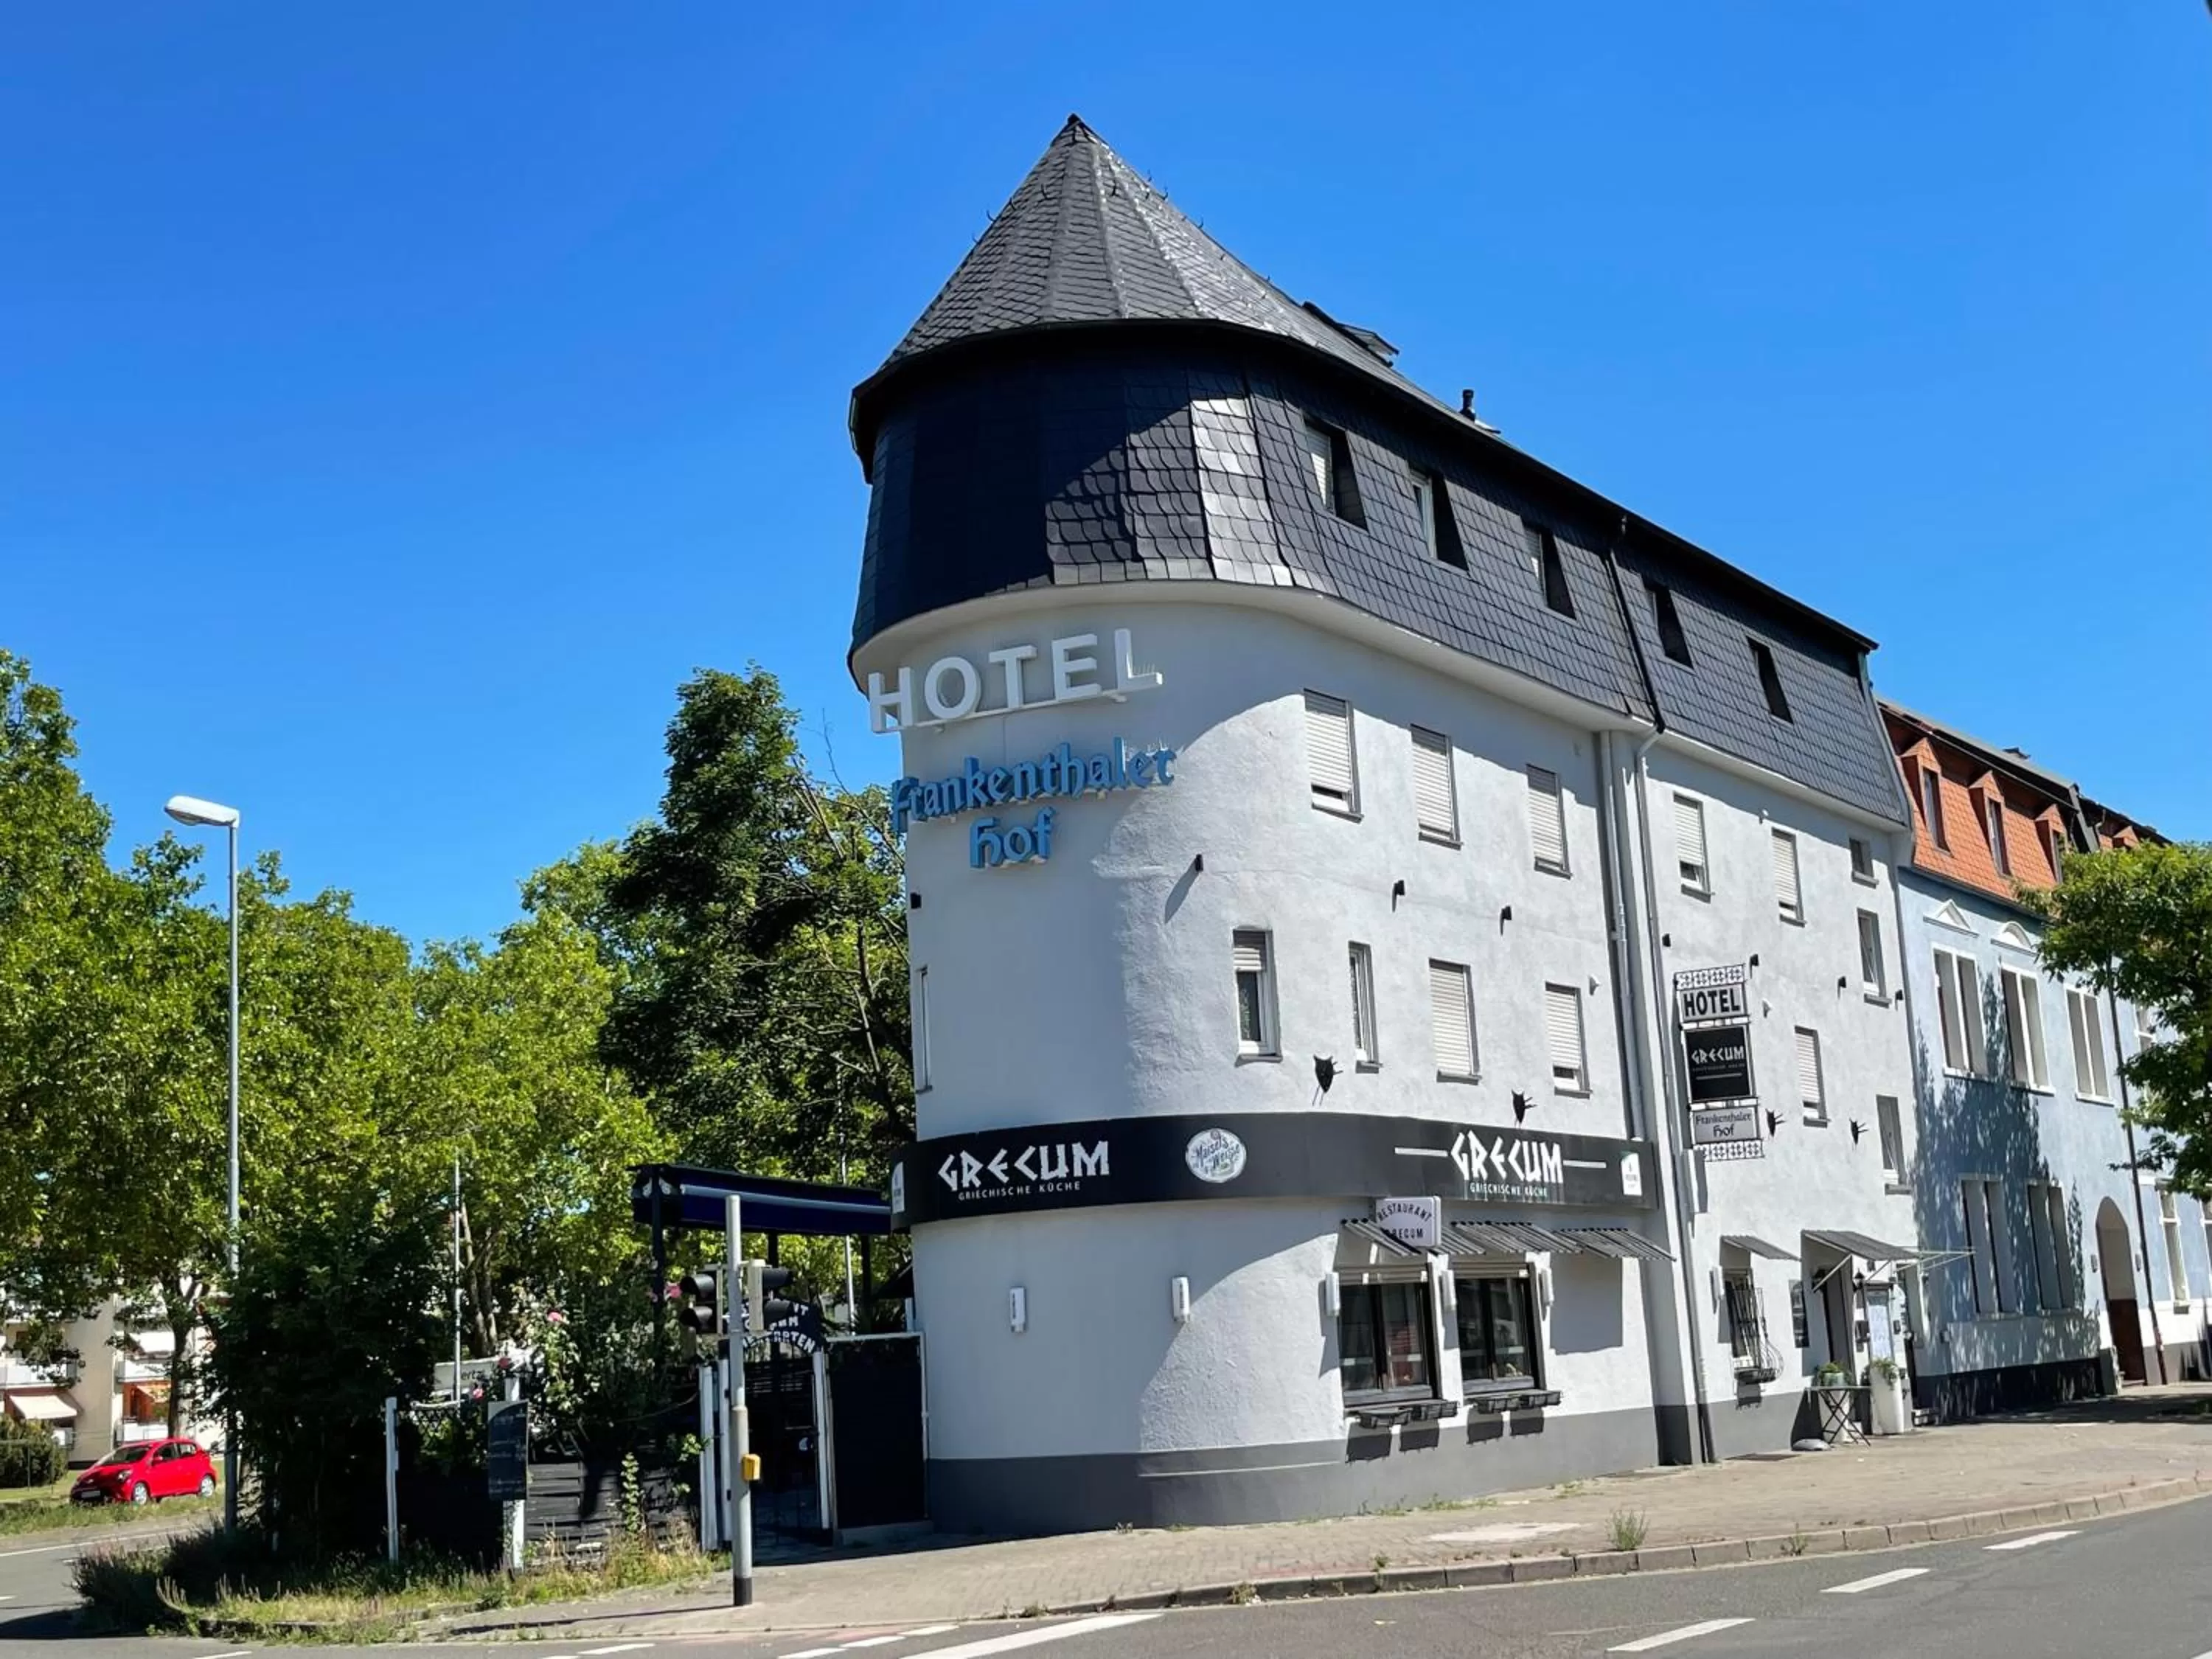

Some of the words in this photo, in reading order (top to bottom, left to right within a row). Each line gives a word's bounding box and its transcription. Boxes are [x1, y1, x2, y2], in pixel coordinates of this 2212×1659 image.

[868, 628, 1163, 733] HOTEL
[891, 737, 1177, 833] Frankenthaler
[1683, 988, 1740, 1017] HOTEL
[1691, 1046, 1745, 1064] GRECUM
[938, 1141, 1109, 1192] GRECUM
[1450, 1130, 1564, 1183] GRECUM
[959, 1185, 1031, 1201] GRIECHISCHE
[1377, 1203, 1432, 1222] RESTAURANT
